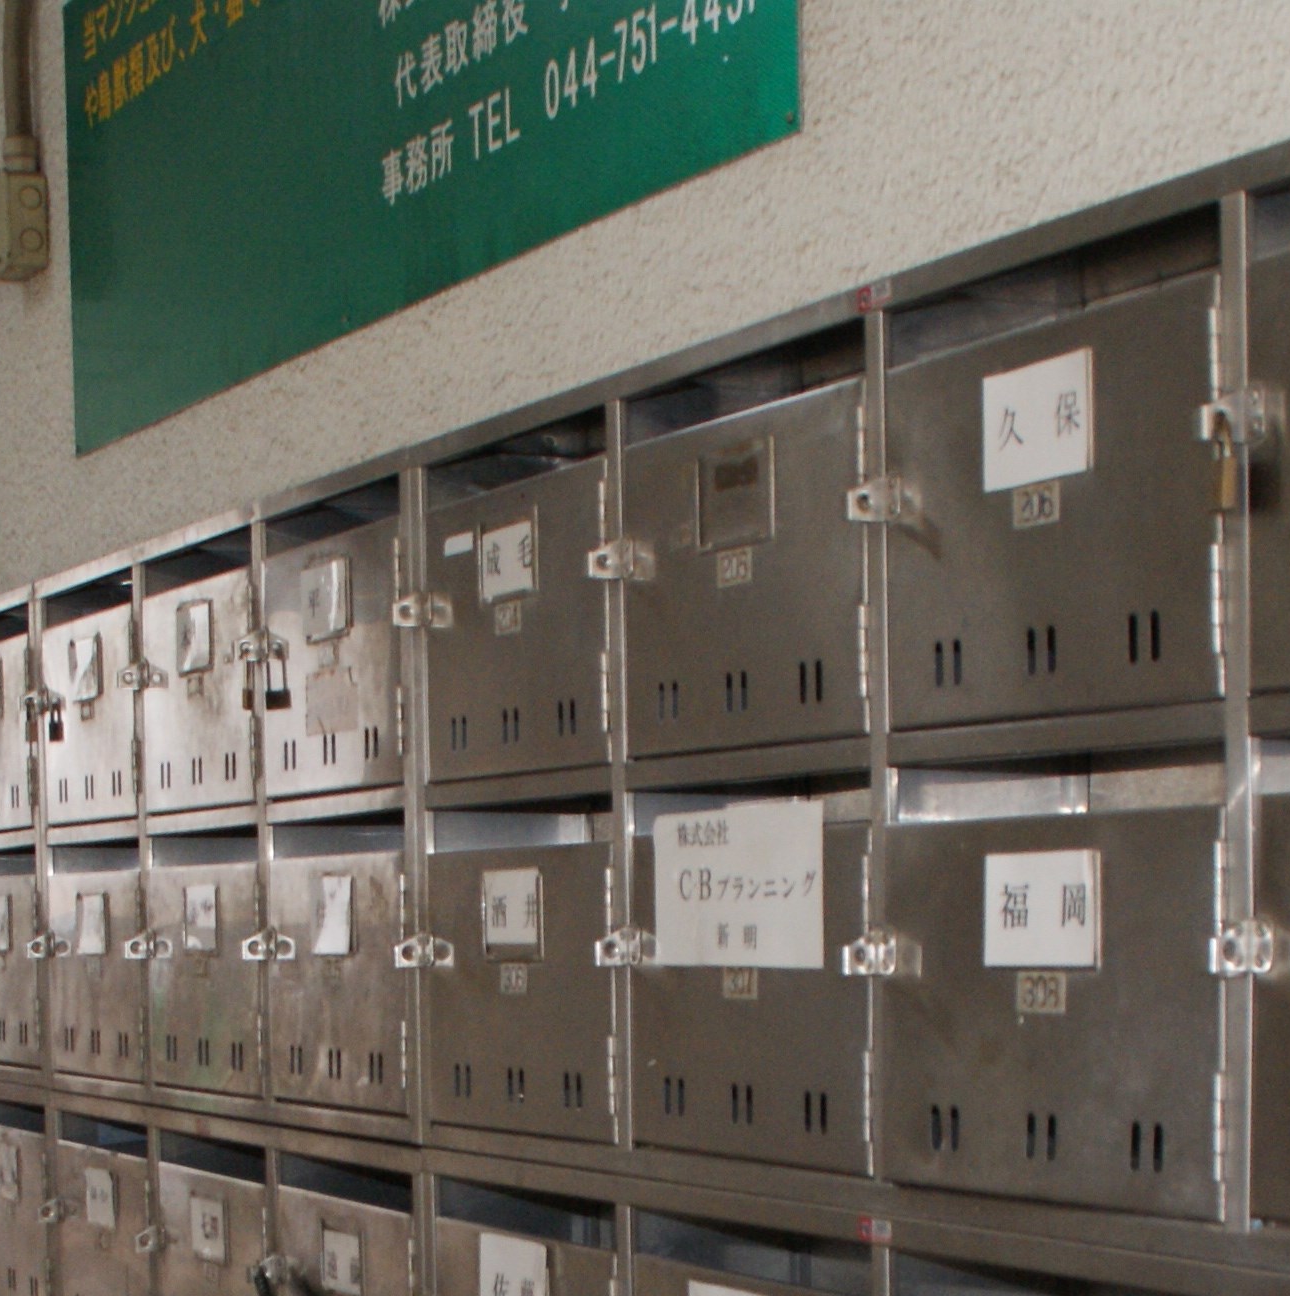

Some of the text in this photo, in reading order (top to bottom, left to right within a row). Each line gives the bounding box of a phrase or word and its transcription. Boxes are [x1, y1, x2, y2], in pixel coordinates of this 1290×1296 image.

[382, 0, 755, 206] 事務所 TEL 044-751-44
[676, 818, 731, 848] 株式会社
[1001, 882, 1087, 930] 福岡
